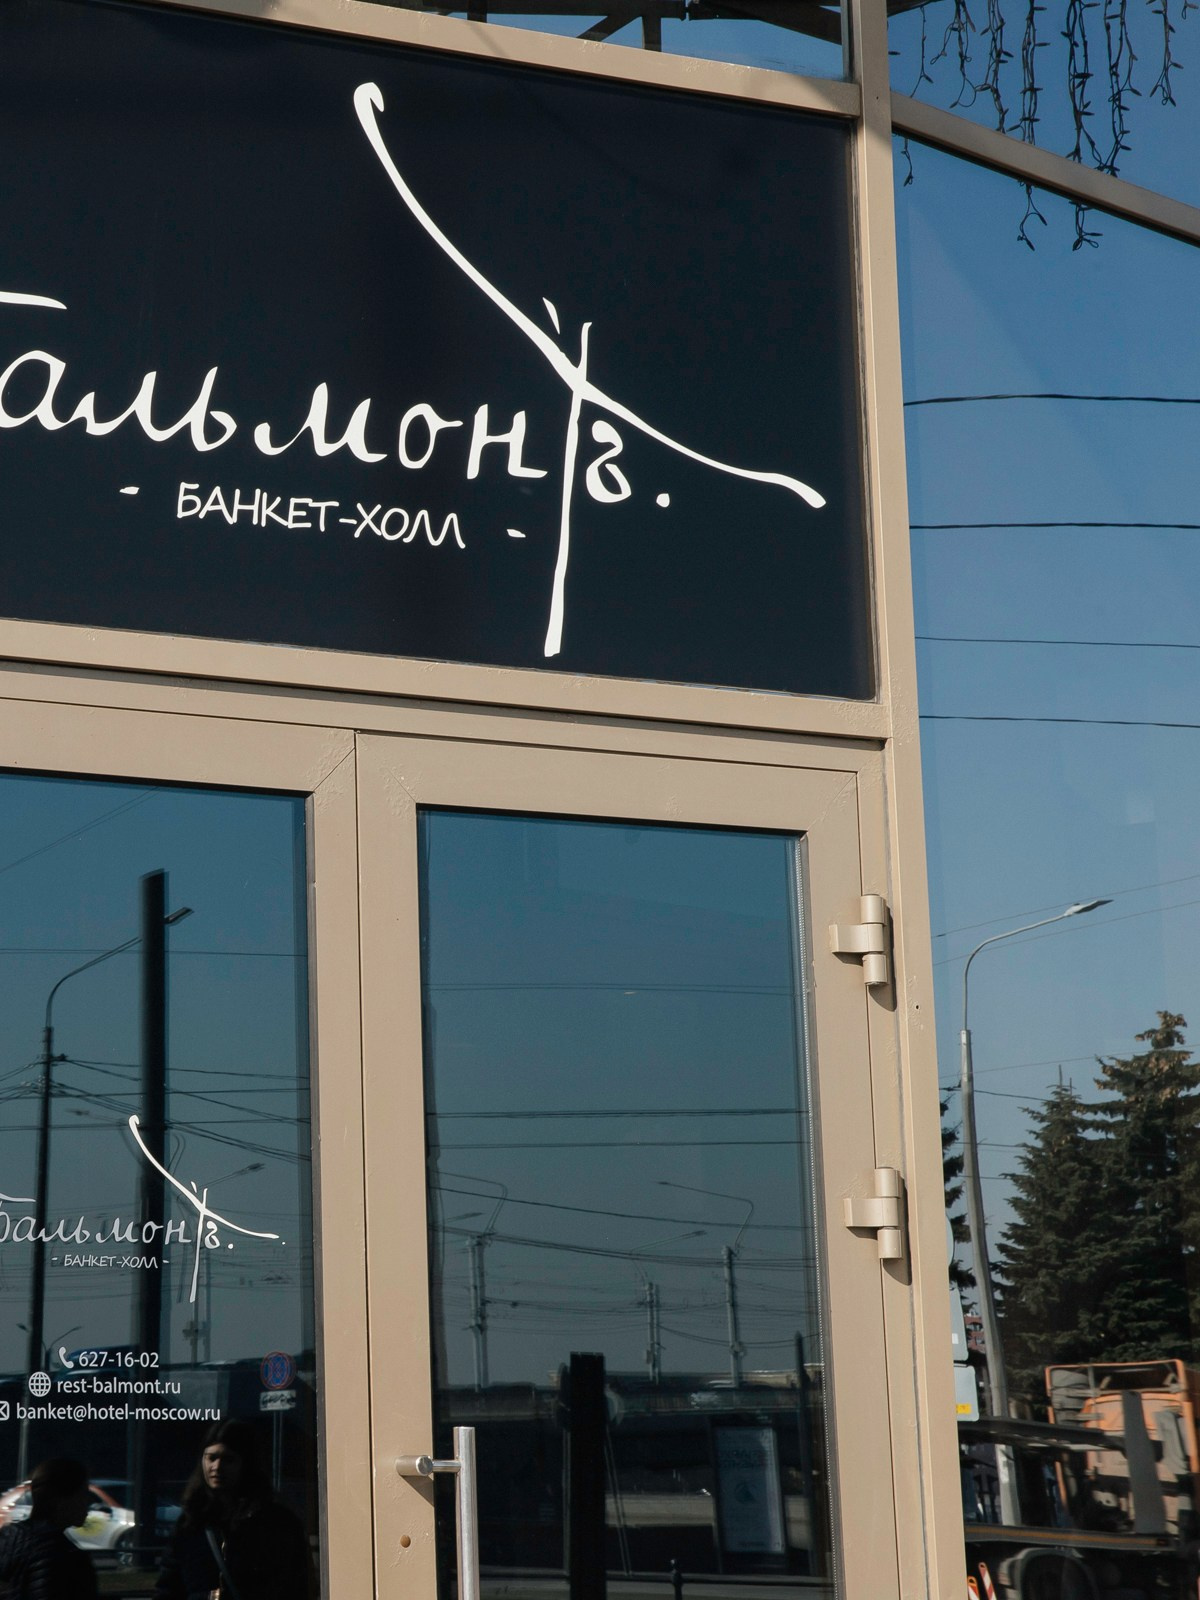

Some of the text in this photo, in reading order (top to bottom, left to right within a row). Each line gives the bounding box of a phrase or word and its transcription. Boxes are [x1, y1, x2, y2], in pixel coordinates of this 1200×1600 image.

[176, 481, 466, 550] БАНКЕТ-ХОЛЛ
[63, 1254, 159, 1270] БАНКЕТ-ХОЛЛ
[77, 1350, 160, 1368] 627-16-02
[56, 1376, 182, 1395] rest-balmont.ru
[15, 1402, 221, 1422] banket@hotel-moscow.ru
